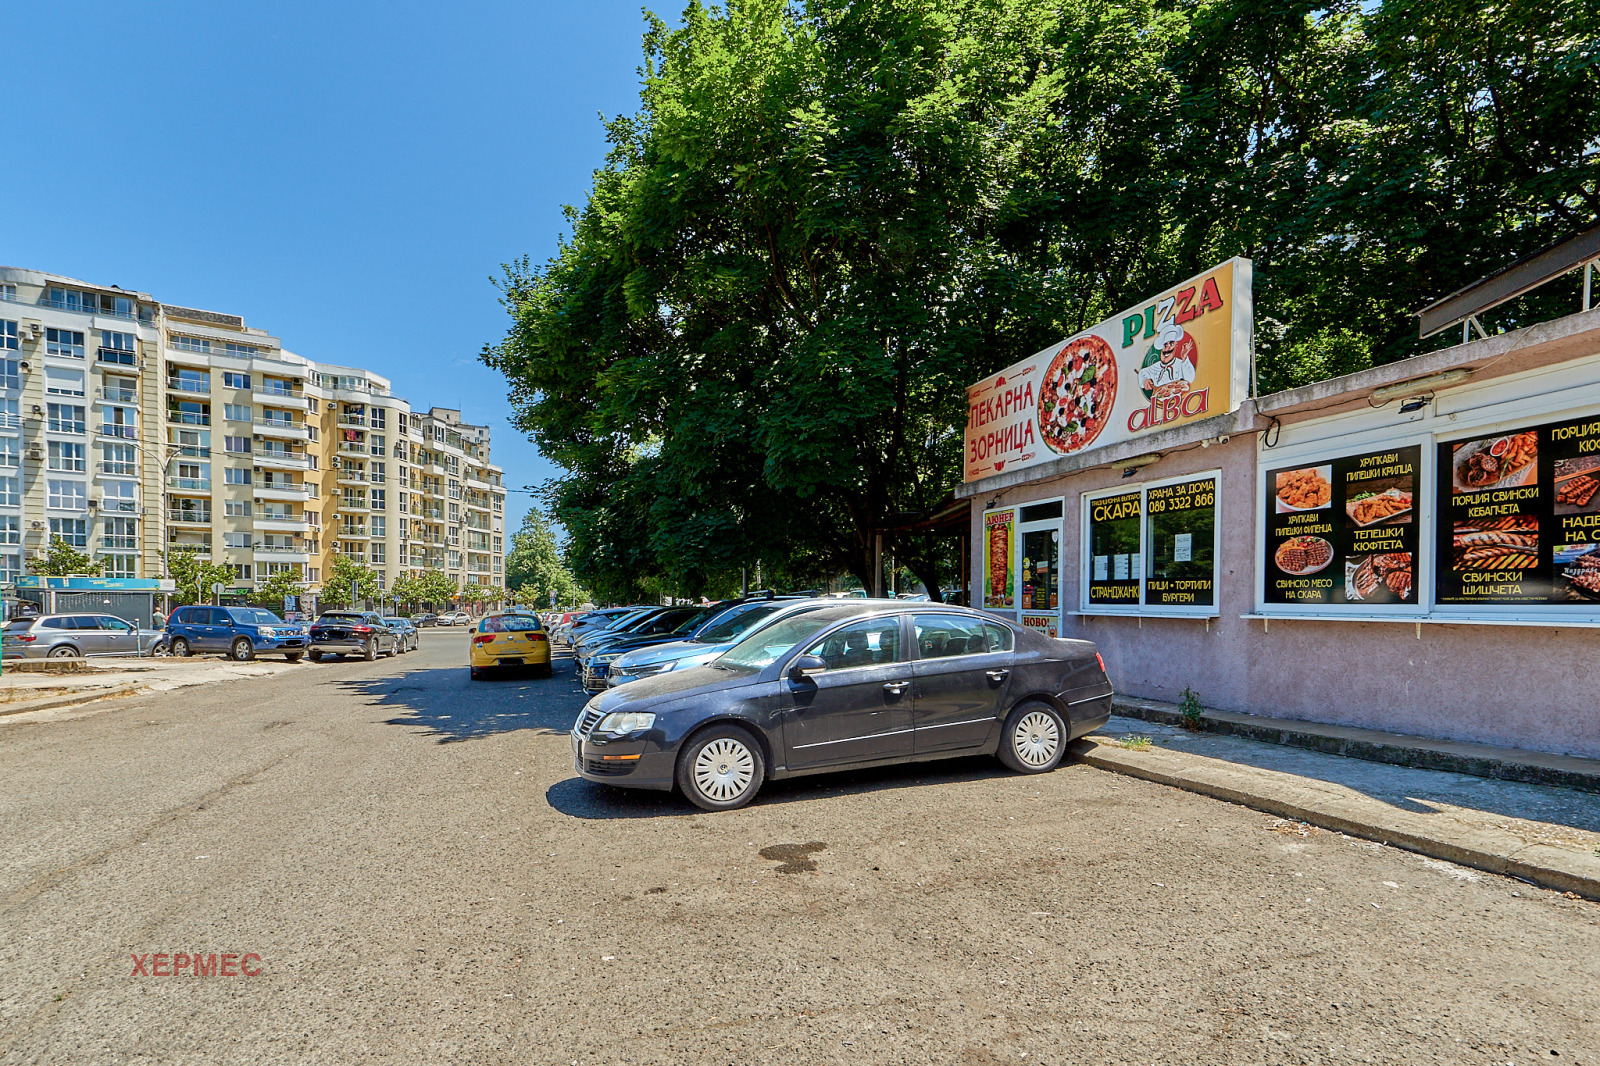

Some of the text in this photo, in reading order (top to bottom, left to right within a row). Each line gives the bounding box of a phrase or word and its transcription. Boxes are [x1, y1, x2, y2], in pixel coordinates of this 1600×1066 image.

[1121, 276, 1223, 348] PIZZA
[970, 380, 1034, 430] ПЕКАРНА
[1552, 422, 1600, 441] ПОРЦИЯ
[970, 418, 1035, 464] ЗОРНИЦА
[1346, 463, 1413, 482] ПИЛЕШКИ КРИЛЦА
[1148, 480, 1215, 500] ХРАНА ЗА ДОМА
[1452, 487, 1539, 507] ПОРЦИЯ СВИНСКИ
[1148, 492, 1214, 513] 089 3322 866
[1094, 501, 1141, 521] СКАРА
[1468, 503, 1520, 518] КЕБАПЧЕТА
[986, 512, 1014, 526] ДЮНЕР
[1275, 523, 1332, 537] ПИЛЕШКИ ФИЛЕНЦА
[1353, 527, 1404, 540] ТЕЛЕШКИ
[1565, 530, 1587, 542] НА
[1353, 539, 1404, 552] КЮФТЕТА
[1275, 578, 1333, 589] СВИНСКО МЕСО
[1462, 571, 1523, 583] СВИНСКИ
[1147, 580, 1212, 591] ПИЦИ ТОРТИЛИ
[1462, 584, 1523, 596] ШИШЧЕТА
[1162, 593, 1195, 603] БУРГЕРИ
[1285, 589, 1322, 599] НА СКАРА
[1023, 617, 1050, 628] НОВО!
